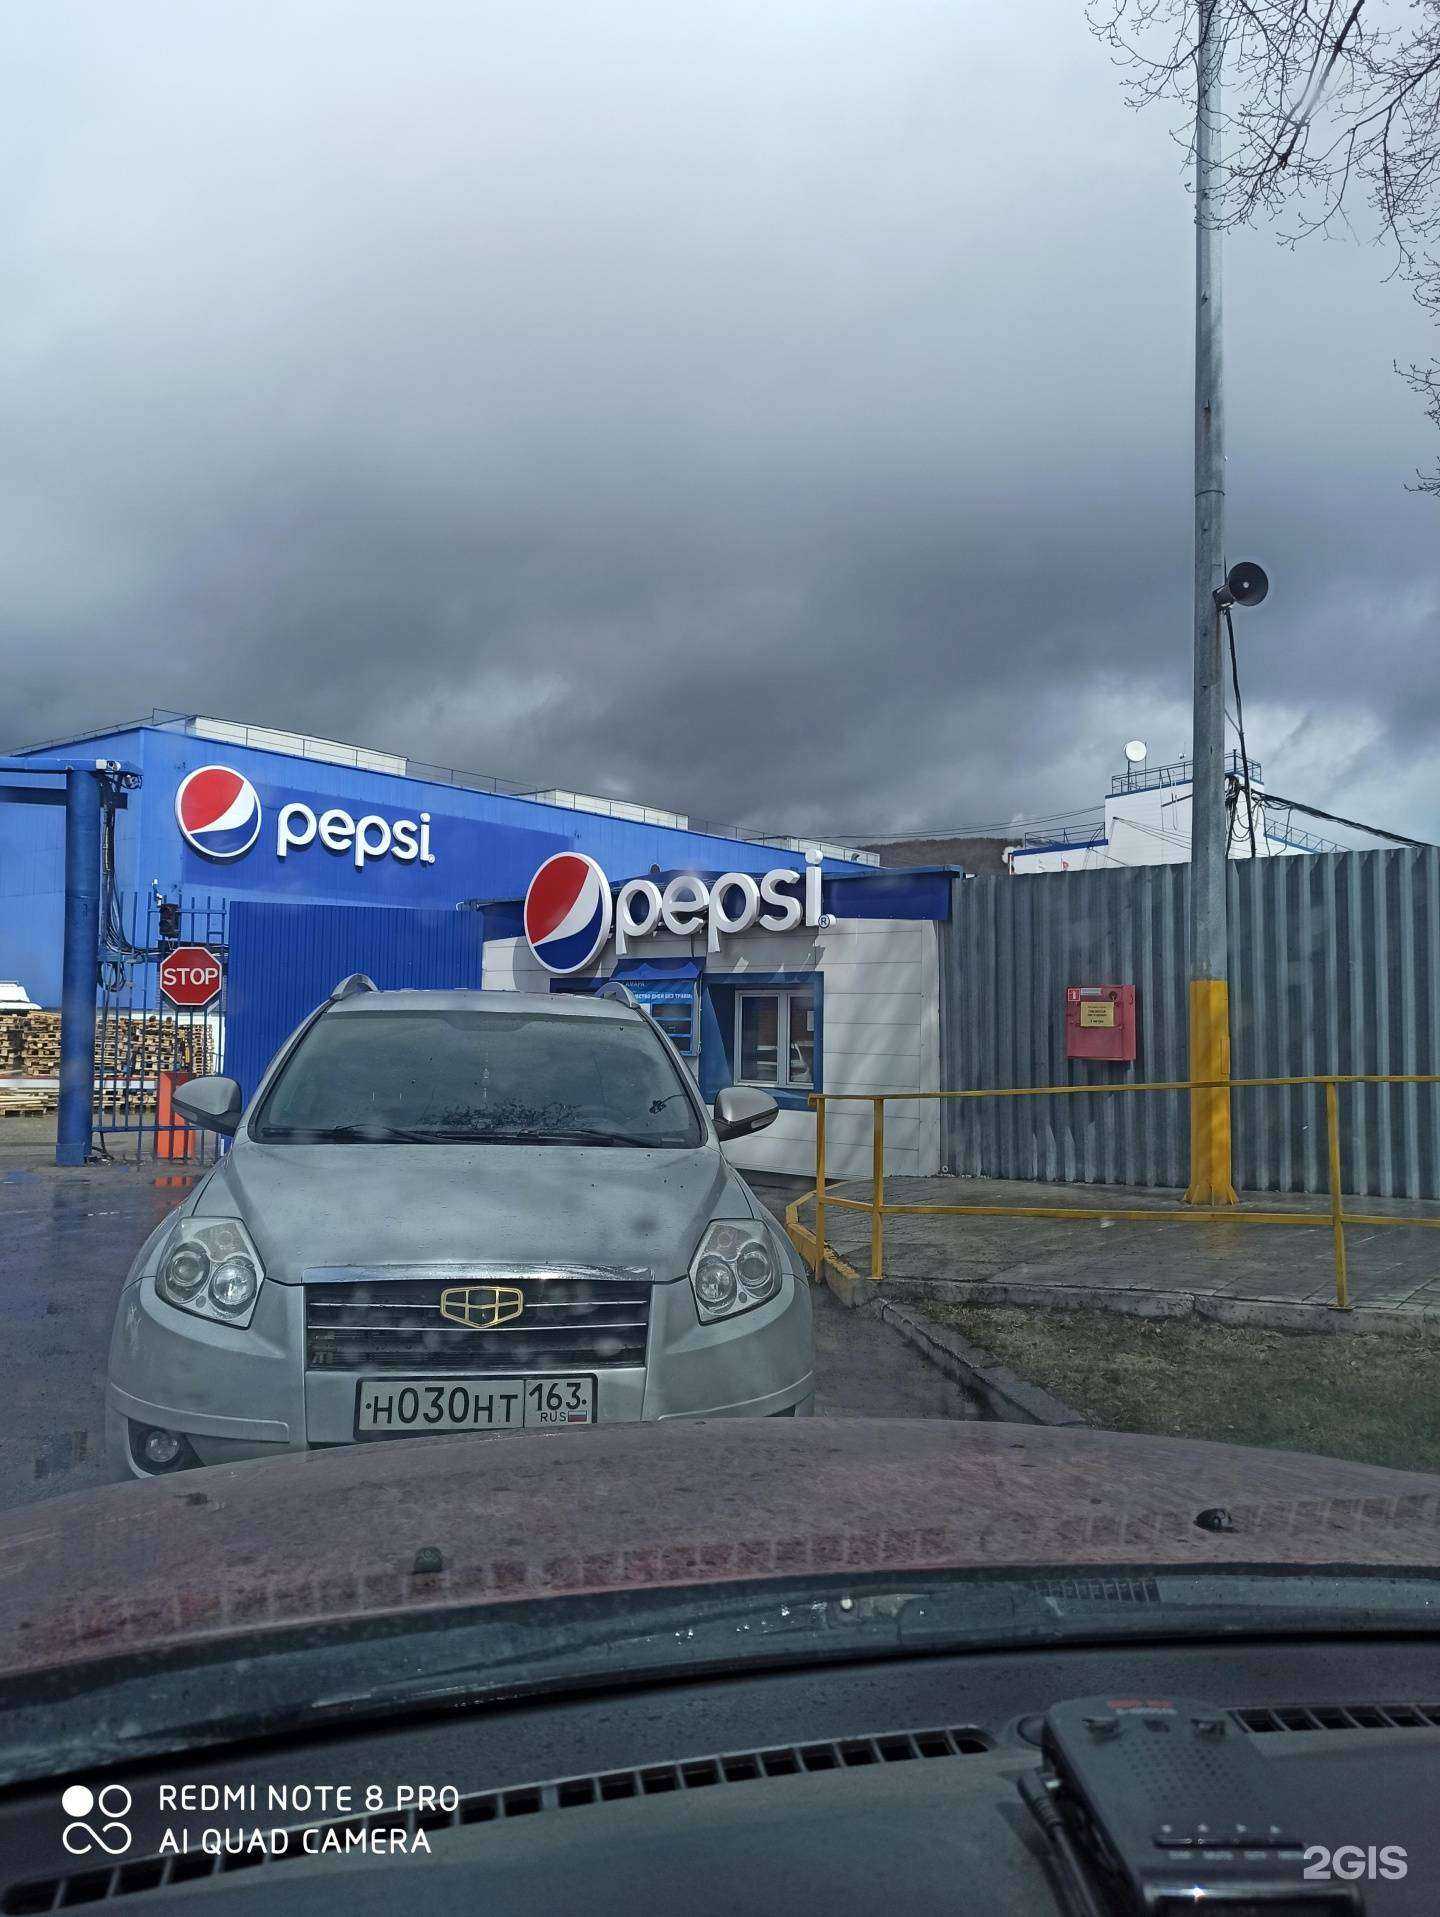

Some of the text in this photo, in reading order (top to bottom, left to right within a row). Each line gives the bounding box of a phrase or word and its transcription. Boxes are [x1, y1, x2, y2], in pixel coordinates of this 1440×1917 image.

[277, 802, 431, 867] pepsi
[615, 849, 824, 955] pepsi
[163, 967, 219, 986] STOP
[528, 1382, 583, 1412] 163
[540, 1411, 567, 1423] RUS
